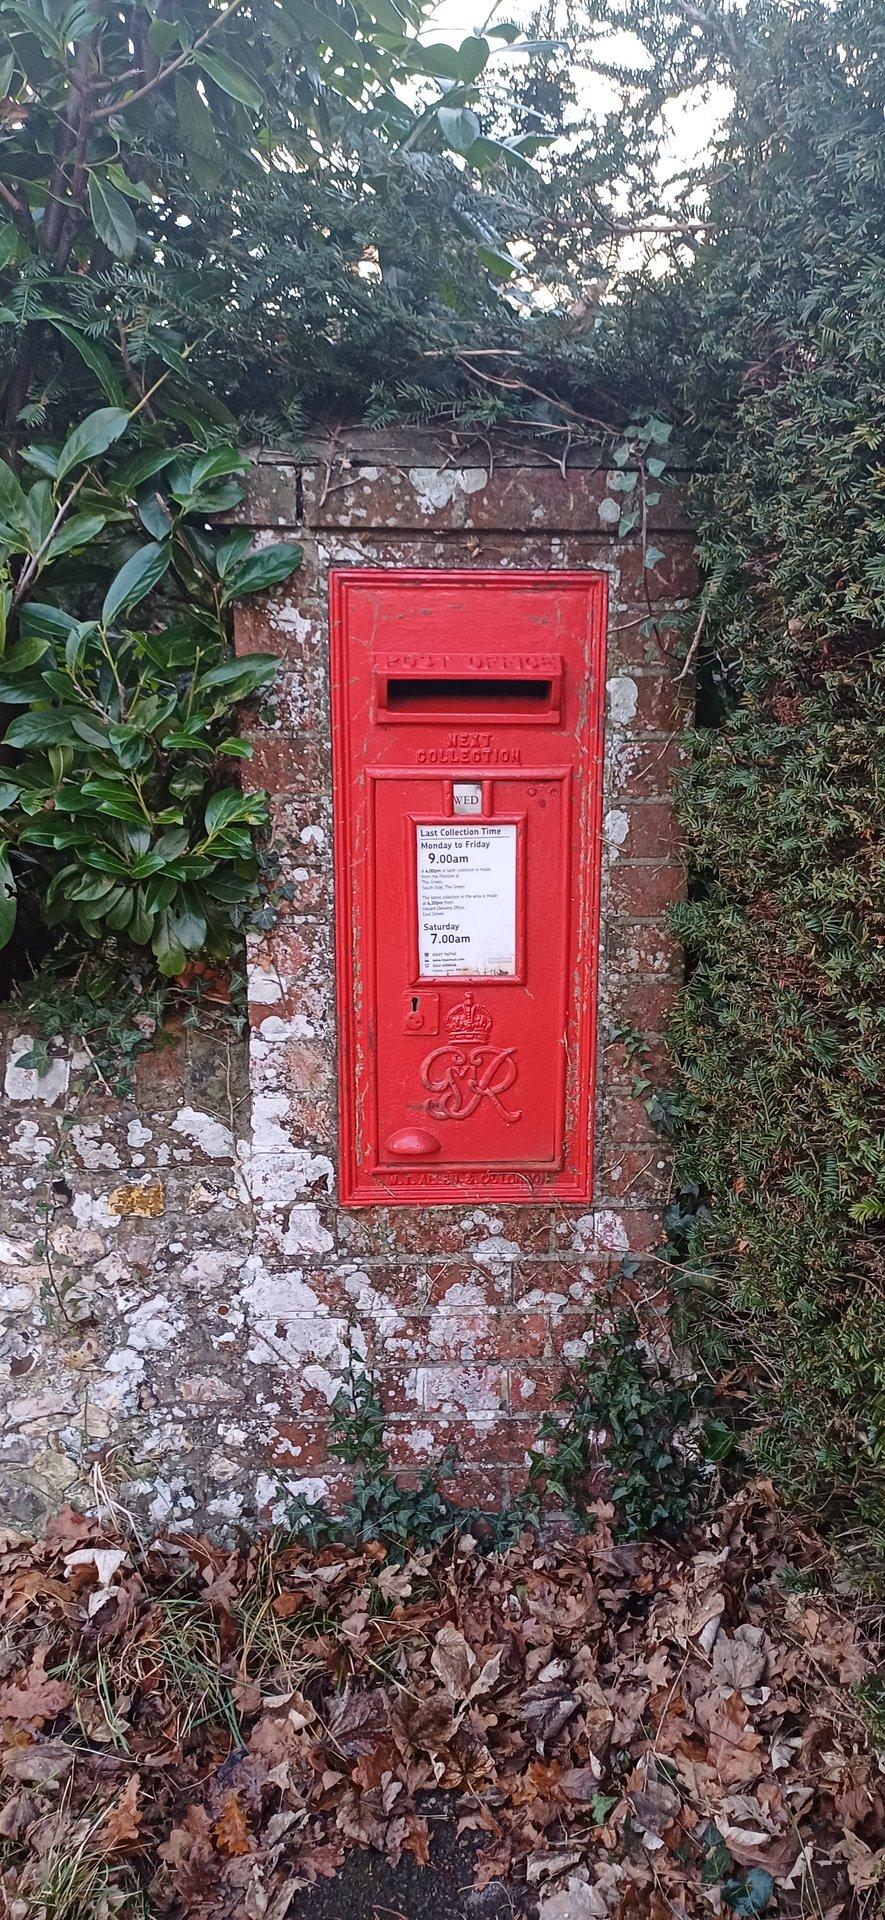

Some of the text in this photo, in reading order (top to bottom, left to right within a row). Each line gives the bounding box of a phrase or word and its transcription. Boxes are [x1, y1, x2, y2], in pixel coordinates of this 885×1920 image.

[386, 655, 558, 670] POST OFFICE
[447, 732, 493, 748] NEXT
[416, 748, 522, 764] COLLECTION
[453, 795, 479, 805] WED
[420, 827, 502, 837] Last Collection Time
[420, 842, 452, 850] Monday
[465, 840, 491, 850] Friday
[428, 852, 469, 864] 9.00am
[423, 923, 460, 931] Saturday
[430, 933, 471, 944] 7.00am
